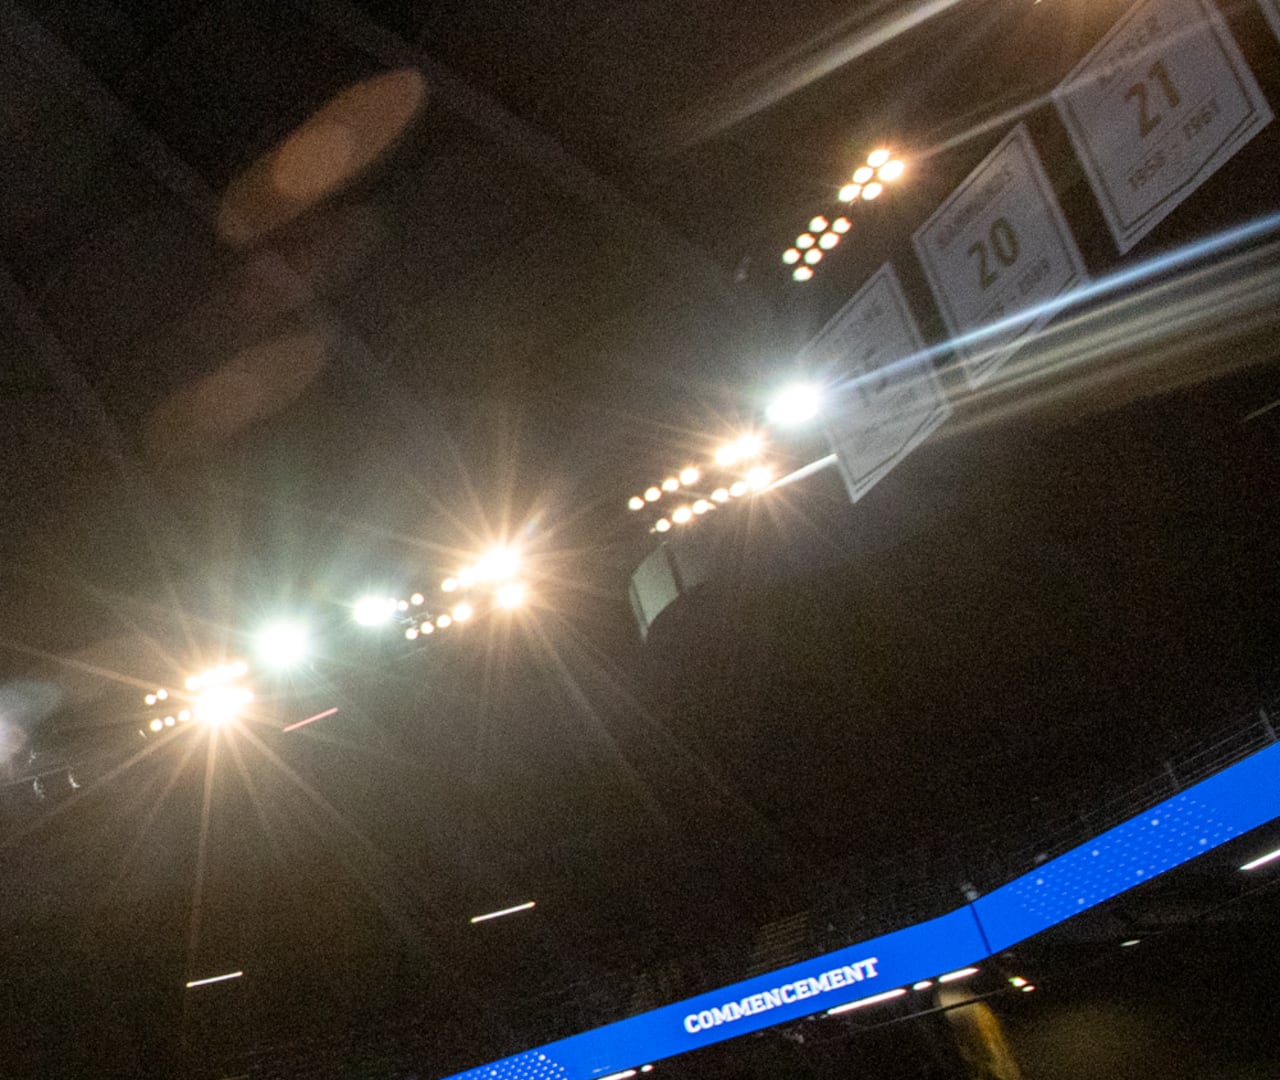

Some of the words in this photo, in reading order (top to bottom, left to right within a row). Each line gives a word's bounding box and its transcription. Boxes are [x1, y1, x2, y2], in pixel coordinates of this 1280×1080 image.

[1124, 58, 1179, 138] 21
[968, 217, 1020, 290] 20
[683, 957, 879, 1033] COMMENCEMENT
